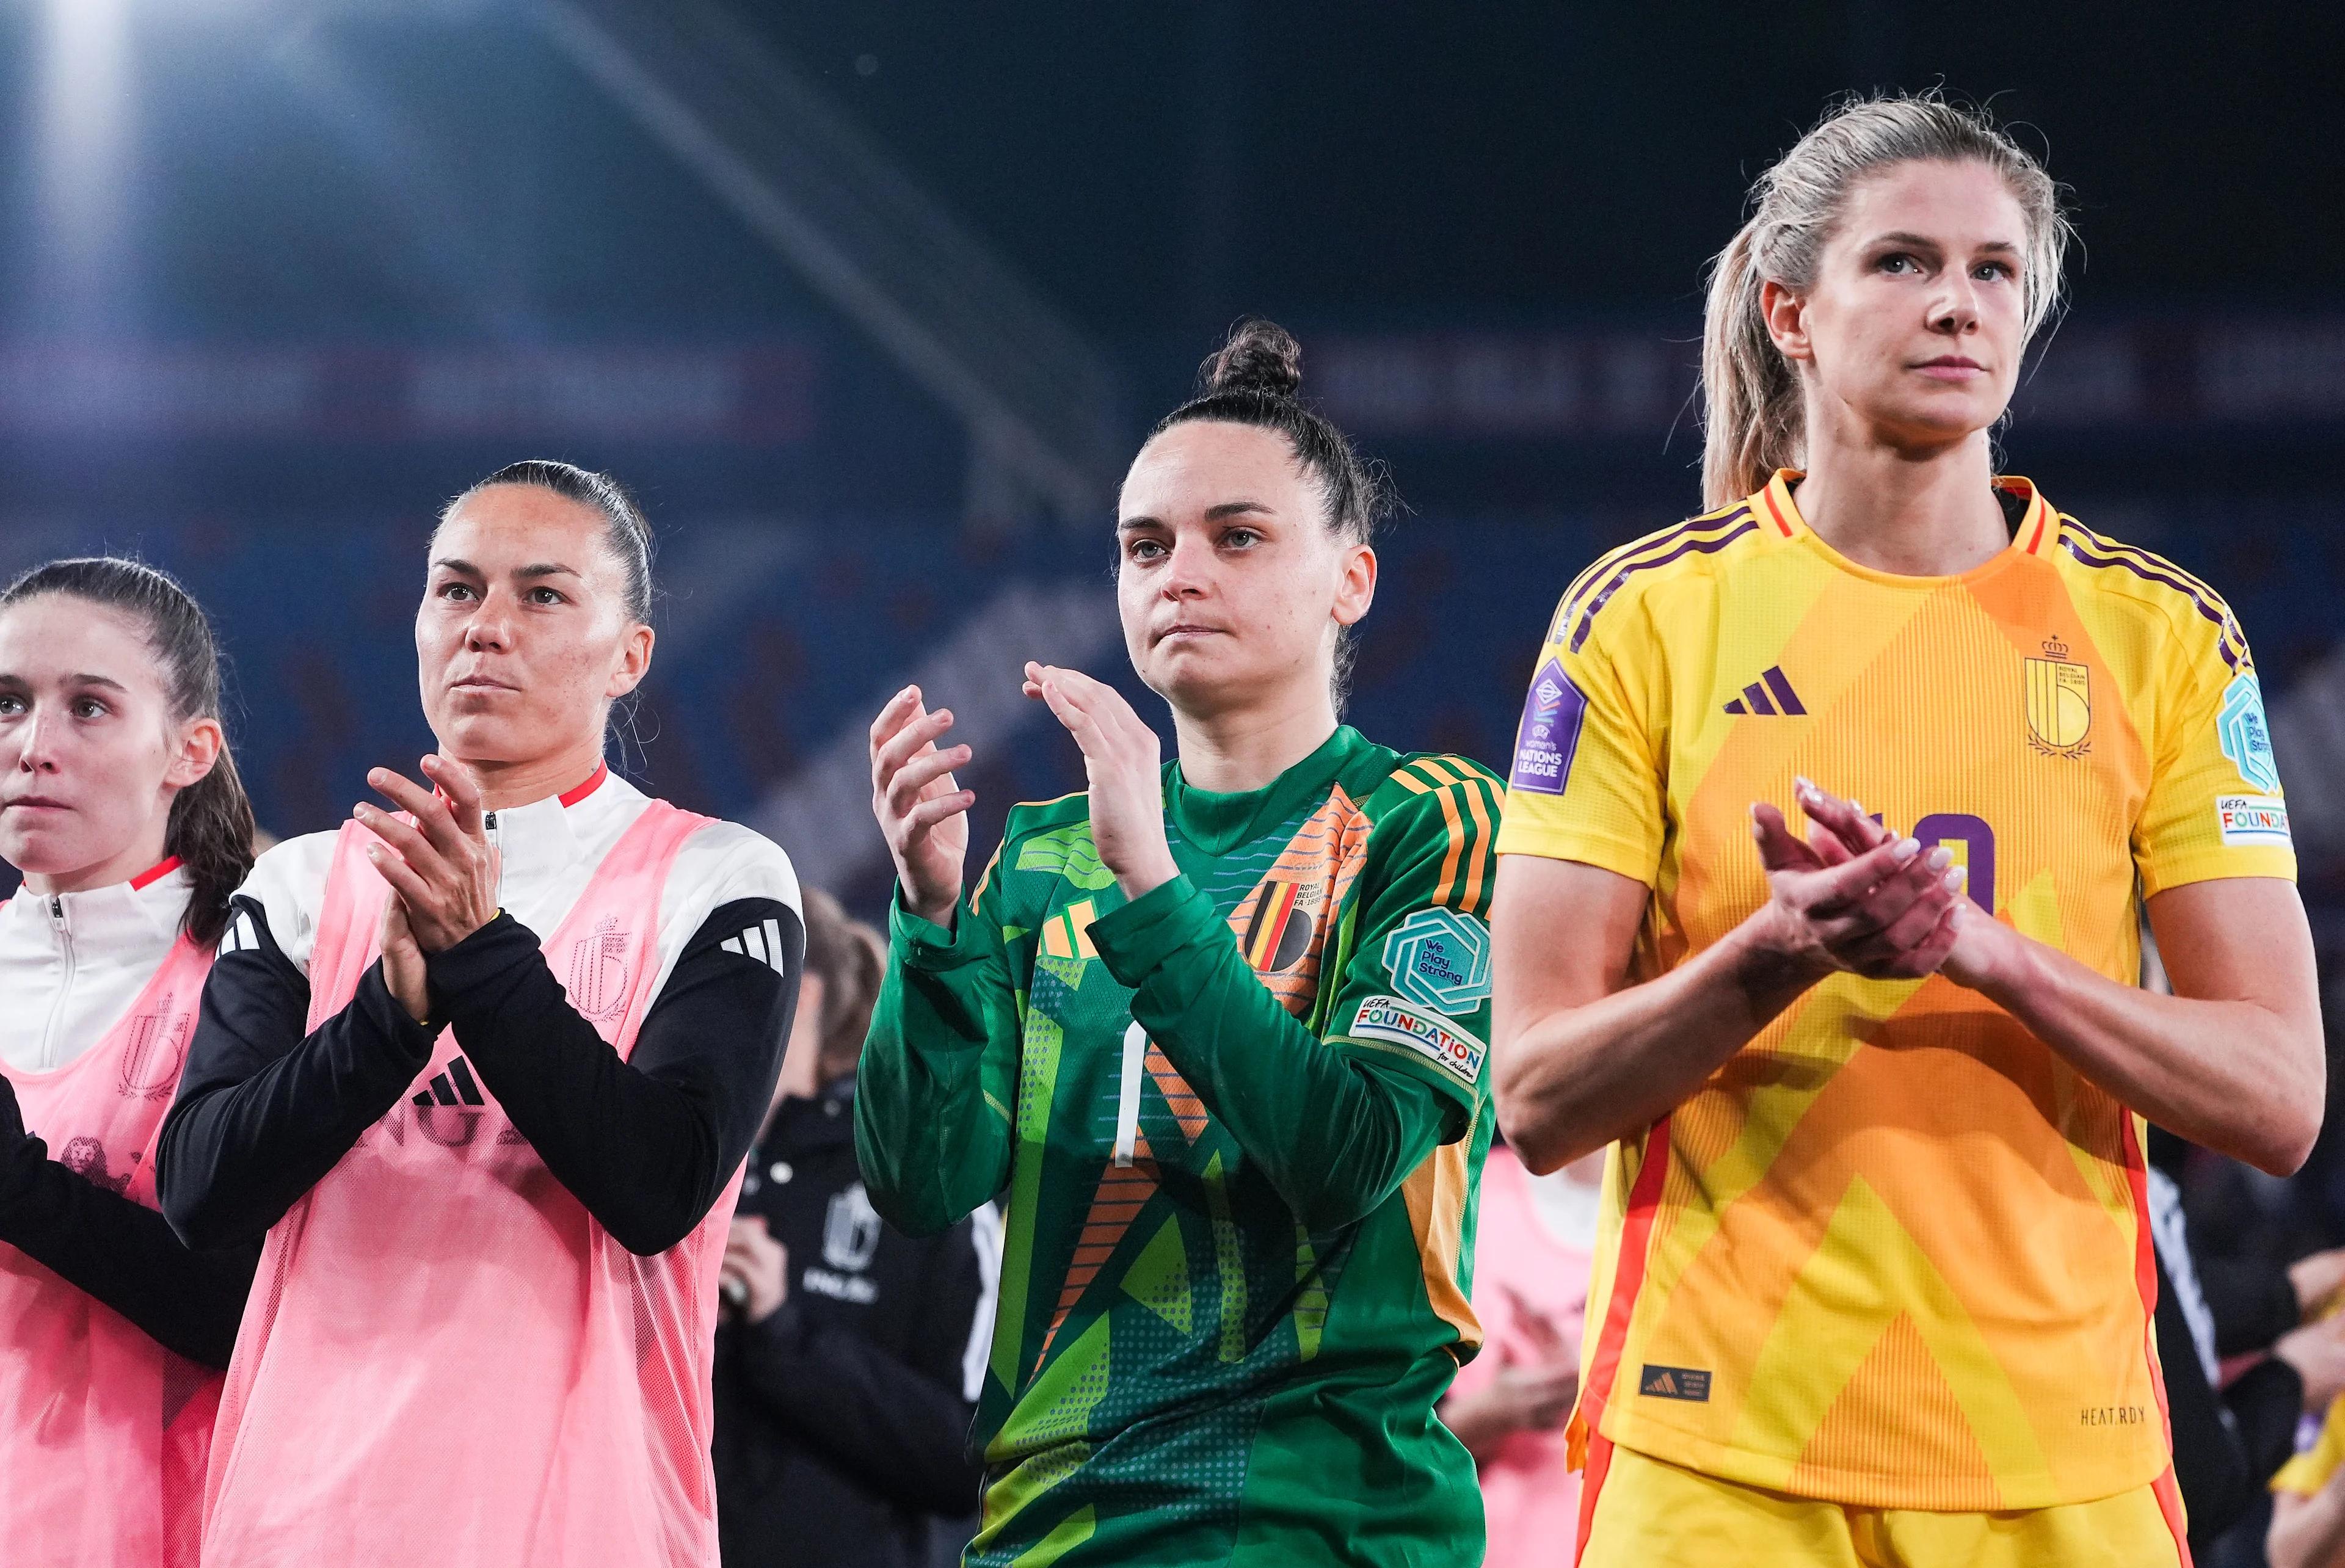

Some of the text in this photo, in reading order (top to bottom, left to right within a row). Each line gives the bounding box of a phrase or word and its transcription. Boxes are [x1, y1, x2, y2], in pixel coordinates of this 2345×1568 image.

[1518, 749, 1563, 766] NATIONS
[1517, 761, 1558, 778] LEAGUE
[2221, 799, 2247, 810] UEFA
[1296, 888, 1322, 898] BELGIAN
[1300, 882, 1320, 891] ROYAL
[1425, 938, 1444, 953] We
[1421, 950, 1450, 970] Play
[1419, 962, 1463, 985] Strong
[1363, 998, 1391, 1008] UEFA
[1356, 1009, 1480, 1069] FOUNDATION
[1436, 1051, 1474, 1080] for children
[1115, 1020, 1147, 1168] 1
[2080, 1406, 2145, 1426] HEAT.RDY
